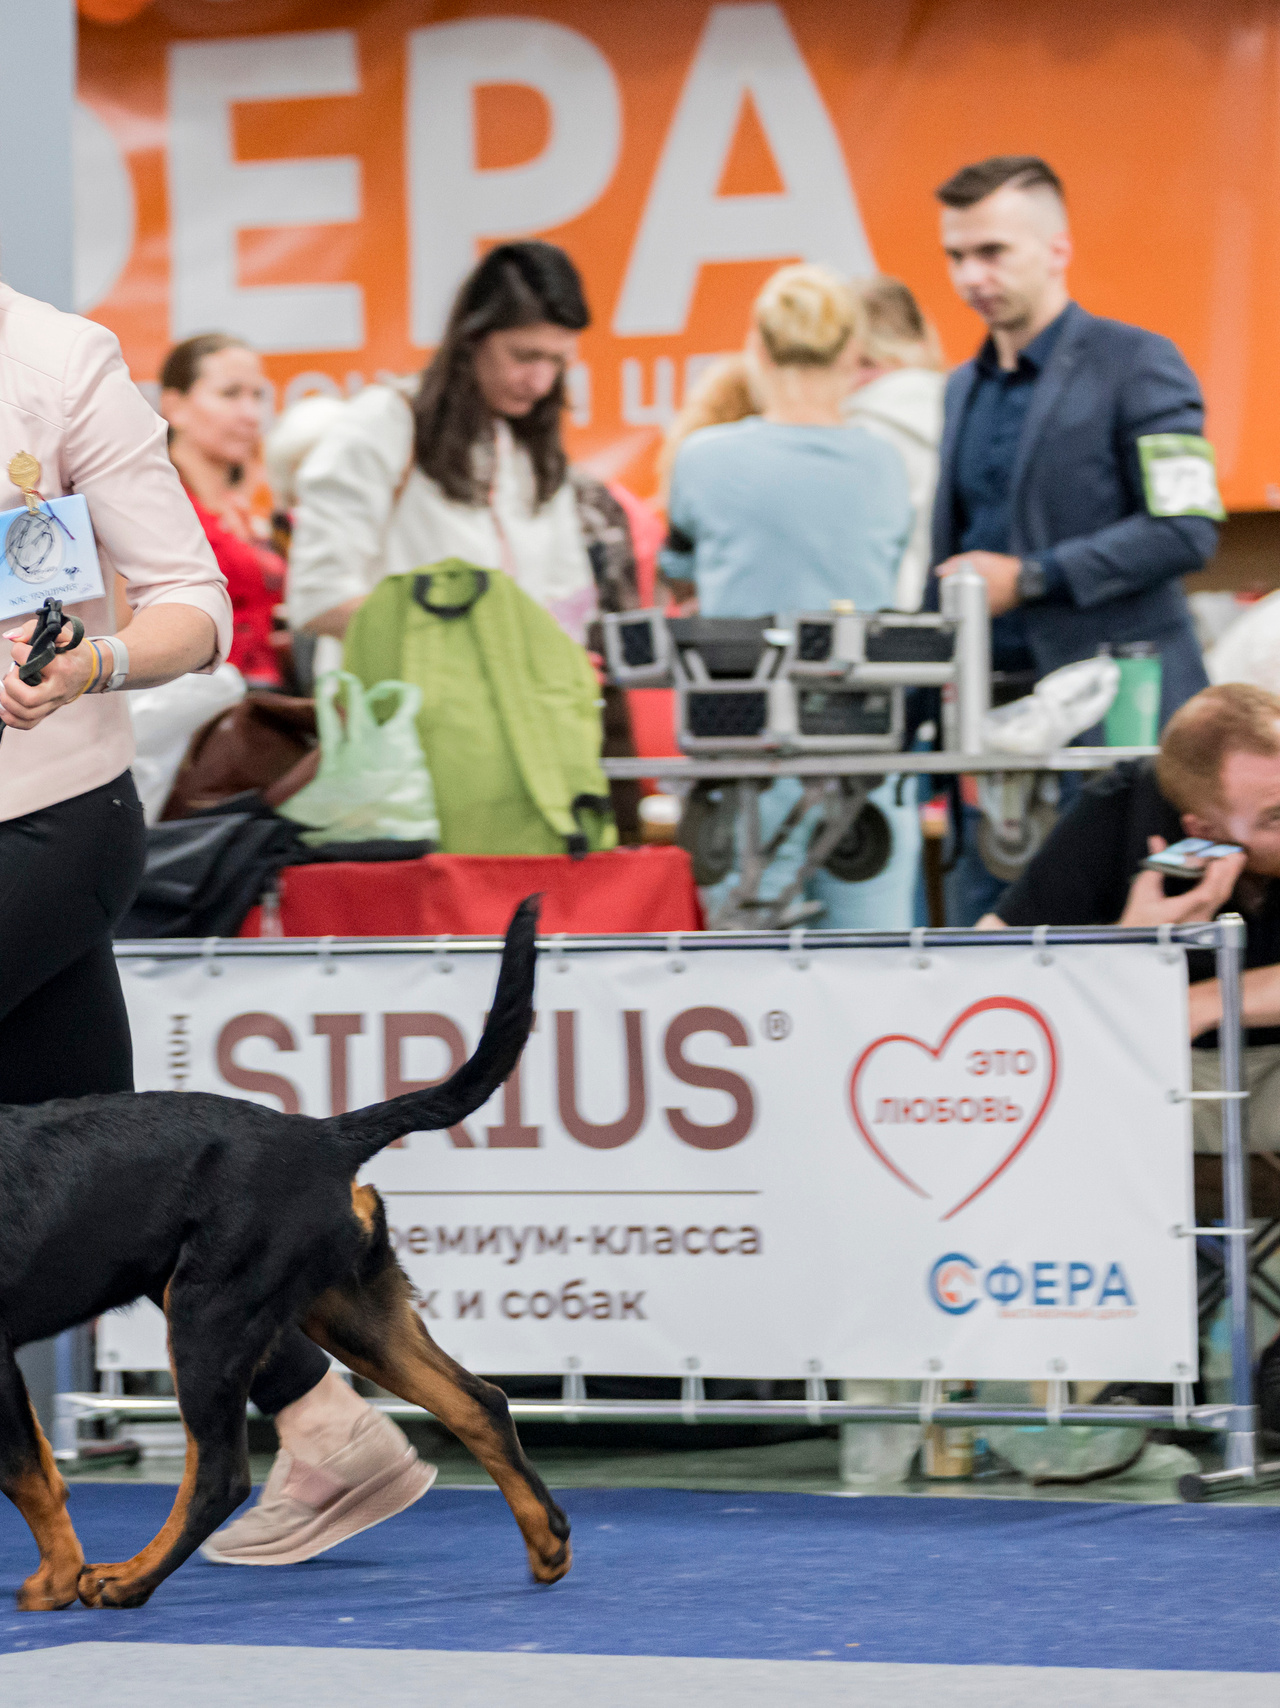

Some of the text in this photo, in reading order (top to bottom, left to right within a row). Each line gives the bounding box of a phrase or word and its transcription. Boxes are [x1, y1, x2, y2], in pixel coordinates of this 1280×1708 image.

[966, 1049, 1038, 1077] ЭТО
[873, 1097, 1023, 1125] ЛЮБОВЬ
[501, 1278, 648, 1321] собак
[928, 1251, 1137, 1316] СФЕРА
